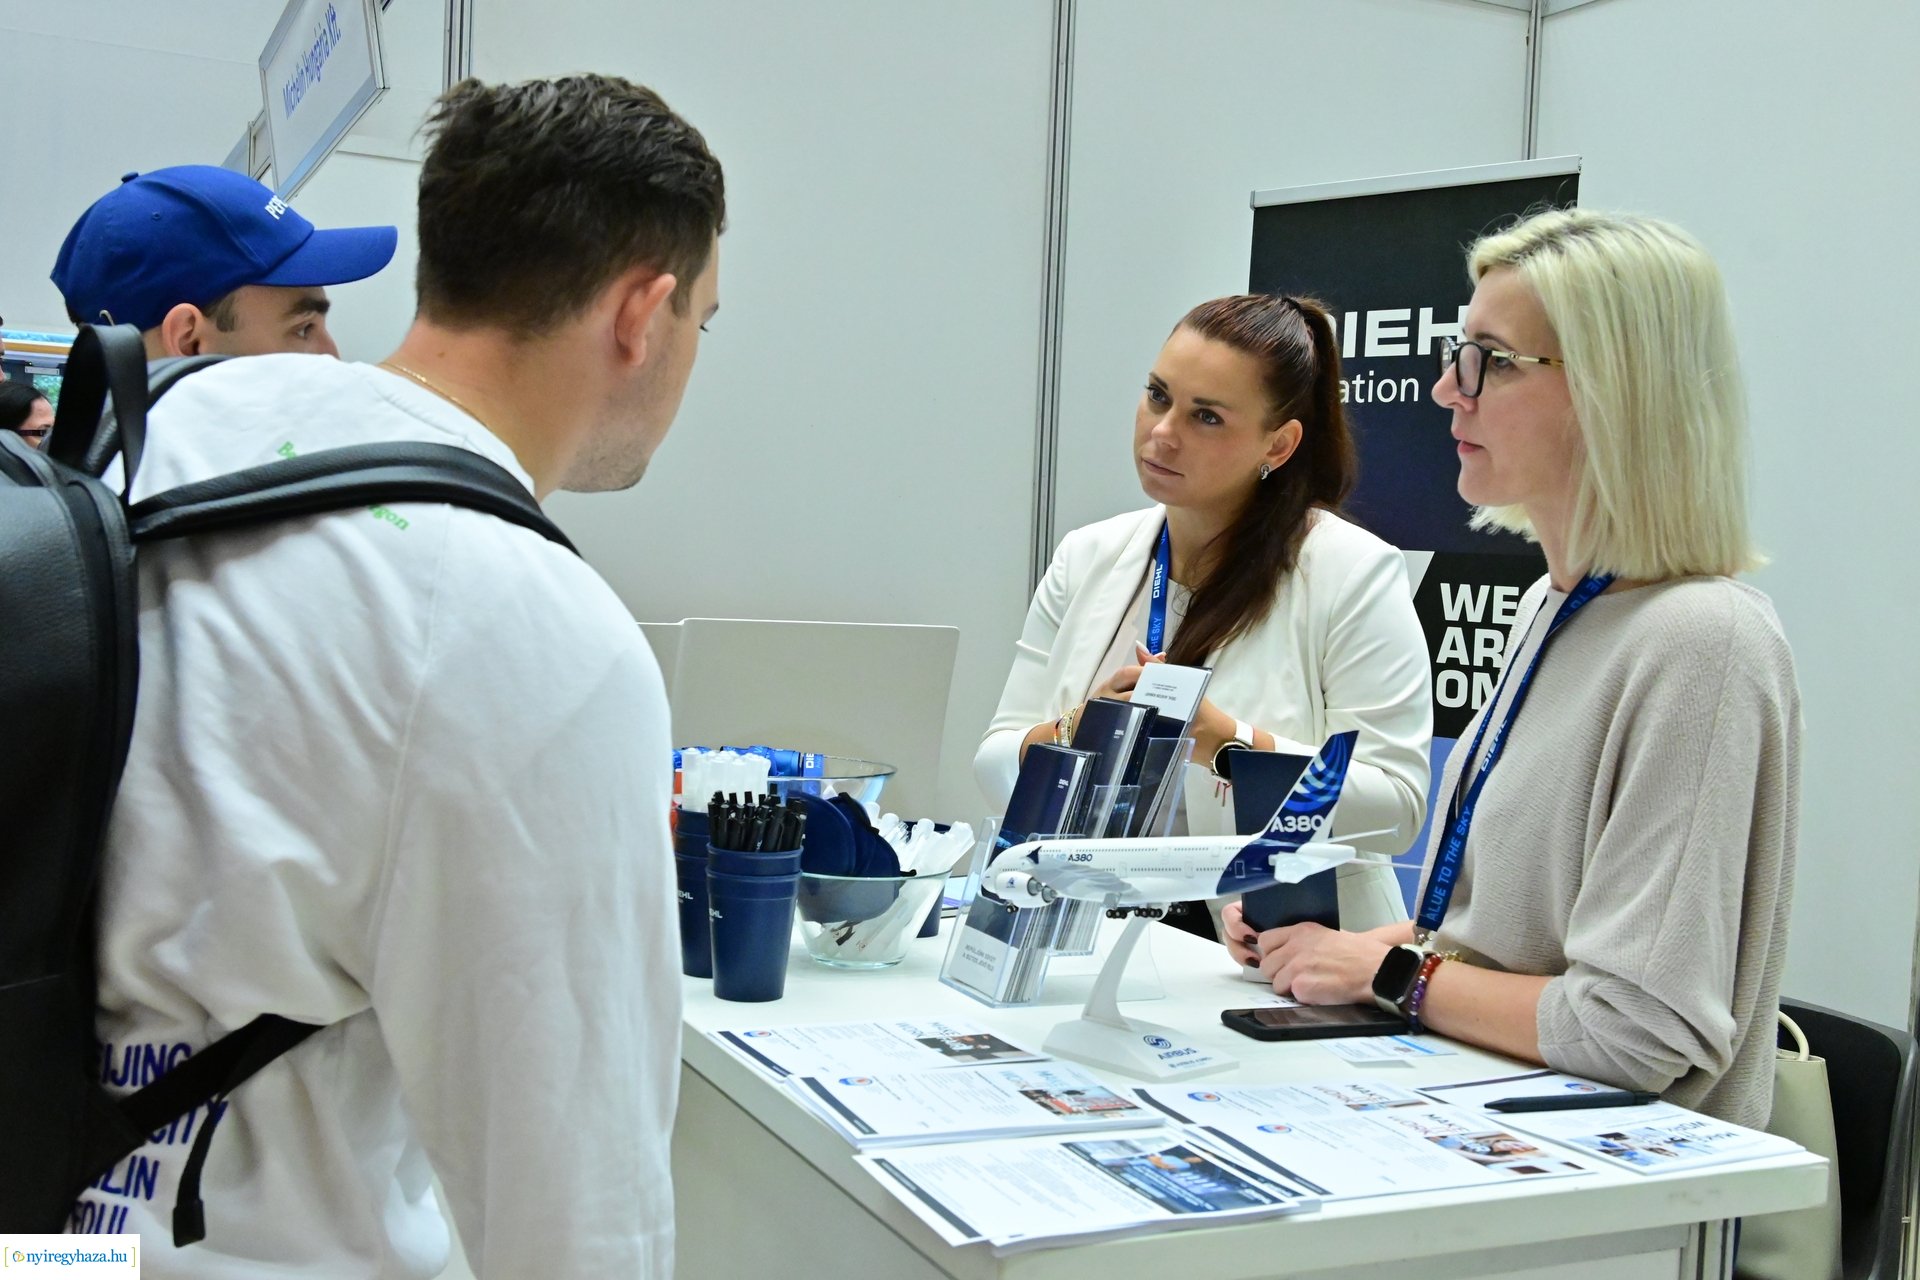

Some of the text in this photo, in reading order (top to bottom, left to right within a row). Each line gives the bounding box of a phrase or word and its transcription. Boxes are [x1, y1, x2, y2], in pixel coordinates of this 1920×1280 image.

[1327, 305, 1470, 359] IEH
[1152, 563, 1164, 599] DIEHL
[1440, 582, 1520, 625] WE
[1151, 616, 1163, 634] SKY
[1270, 814, 1325, 833] A380
[1068, 853, 1093, 862] A380
[1424, 804, 1473, 922] ALUE TO THE SKY
[90, 1154, 160, 1201] LIN
